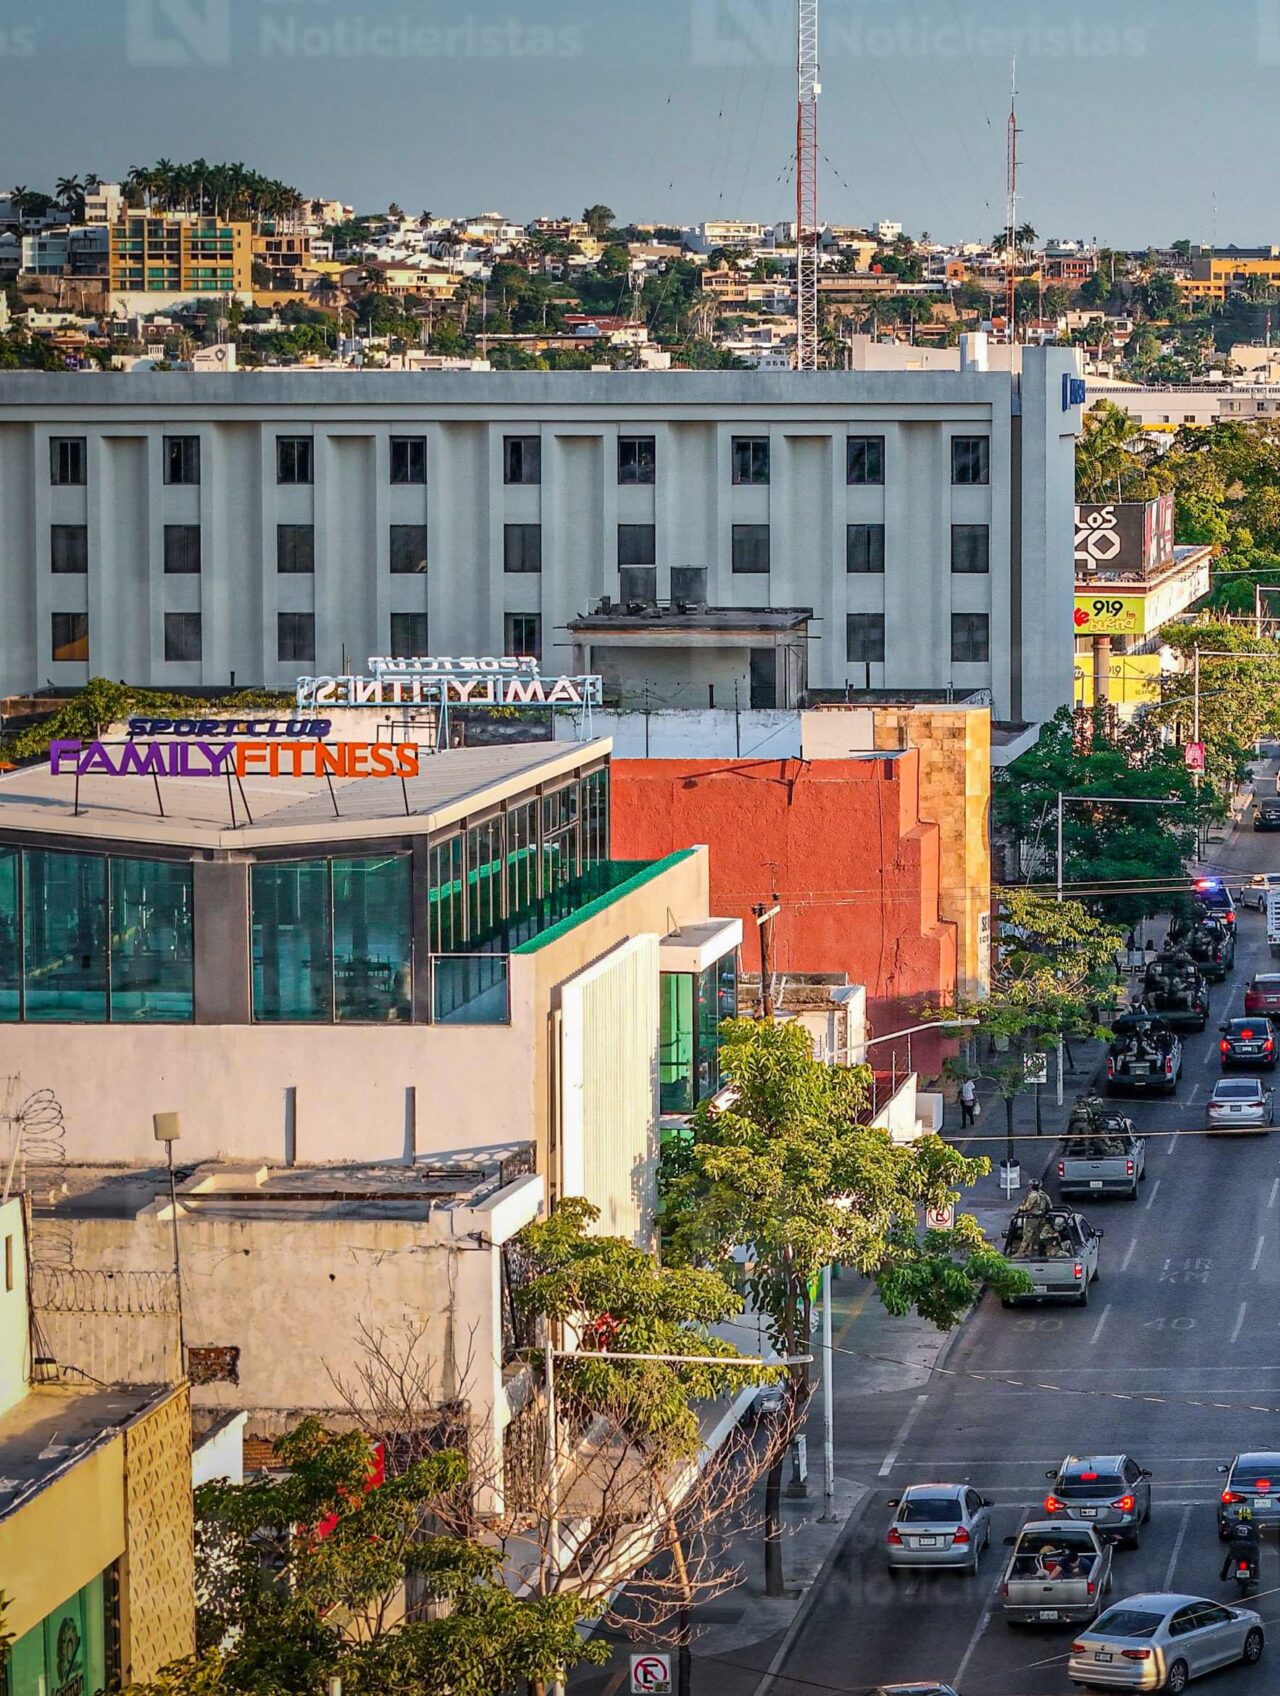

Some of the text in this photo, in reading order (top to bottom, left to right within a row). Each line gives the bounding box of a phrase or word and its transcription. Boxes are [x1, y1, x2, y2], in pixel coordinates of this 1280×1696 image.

[1093, 600, 1123, 616] 91.9
[128, 718, 332, 738] SPORT CLUB
